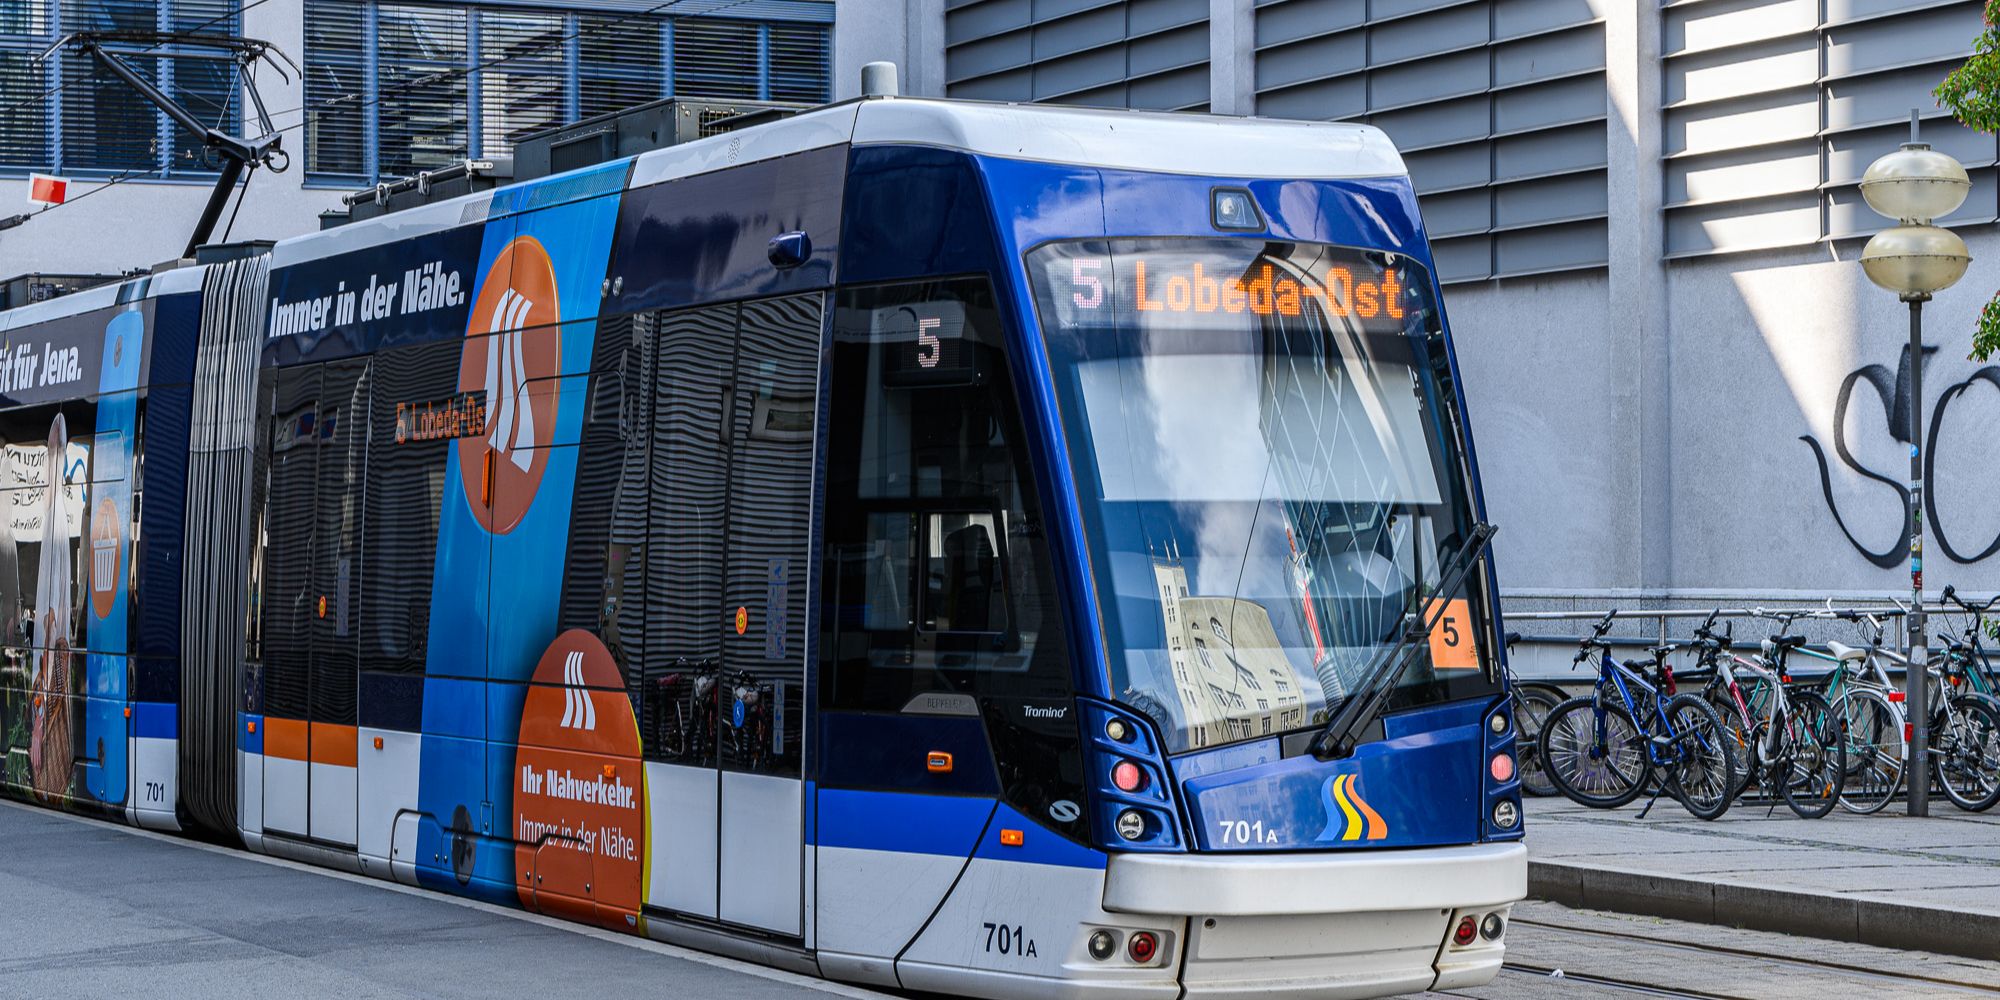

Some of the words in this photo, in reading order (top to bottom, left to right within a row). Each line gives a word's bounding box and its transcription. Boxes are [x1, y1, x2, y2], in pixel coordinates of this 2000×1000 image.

[269, 295, 332, 338] Immer
[335, 281, 356, 326] in
[361, 275, 397, 322] der
[401, 261, 465, 314] Nähe.
[1073, 258, 1102, 309] 5
[1136, 260, 1403, 318] Lobeda-Ost
[918, 318, 940, 367] 5
[13, 343, 39, 391] für
[39, 342, 82, 388] Jena.
[412, 396, 486, 440] Lobeda-Os
[1443, 617, 1459, 647] 5
[1023, 705, 1067, 718] Tramino
[146, 782, 164, 802] 701
[522, 764, 543, 795] Ihr
[546, 769, 636, 809] Nahverkehr.
[519, 812, 558, 847] Immer
[561, 818, 574, 849] in
[576, 820, 597, 854] der
[600, 826, 637, 861] Nähe.
